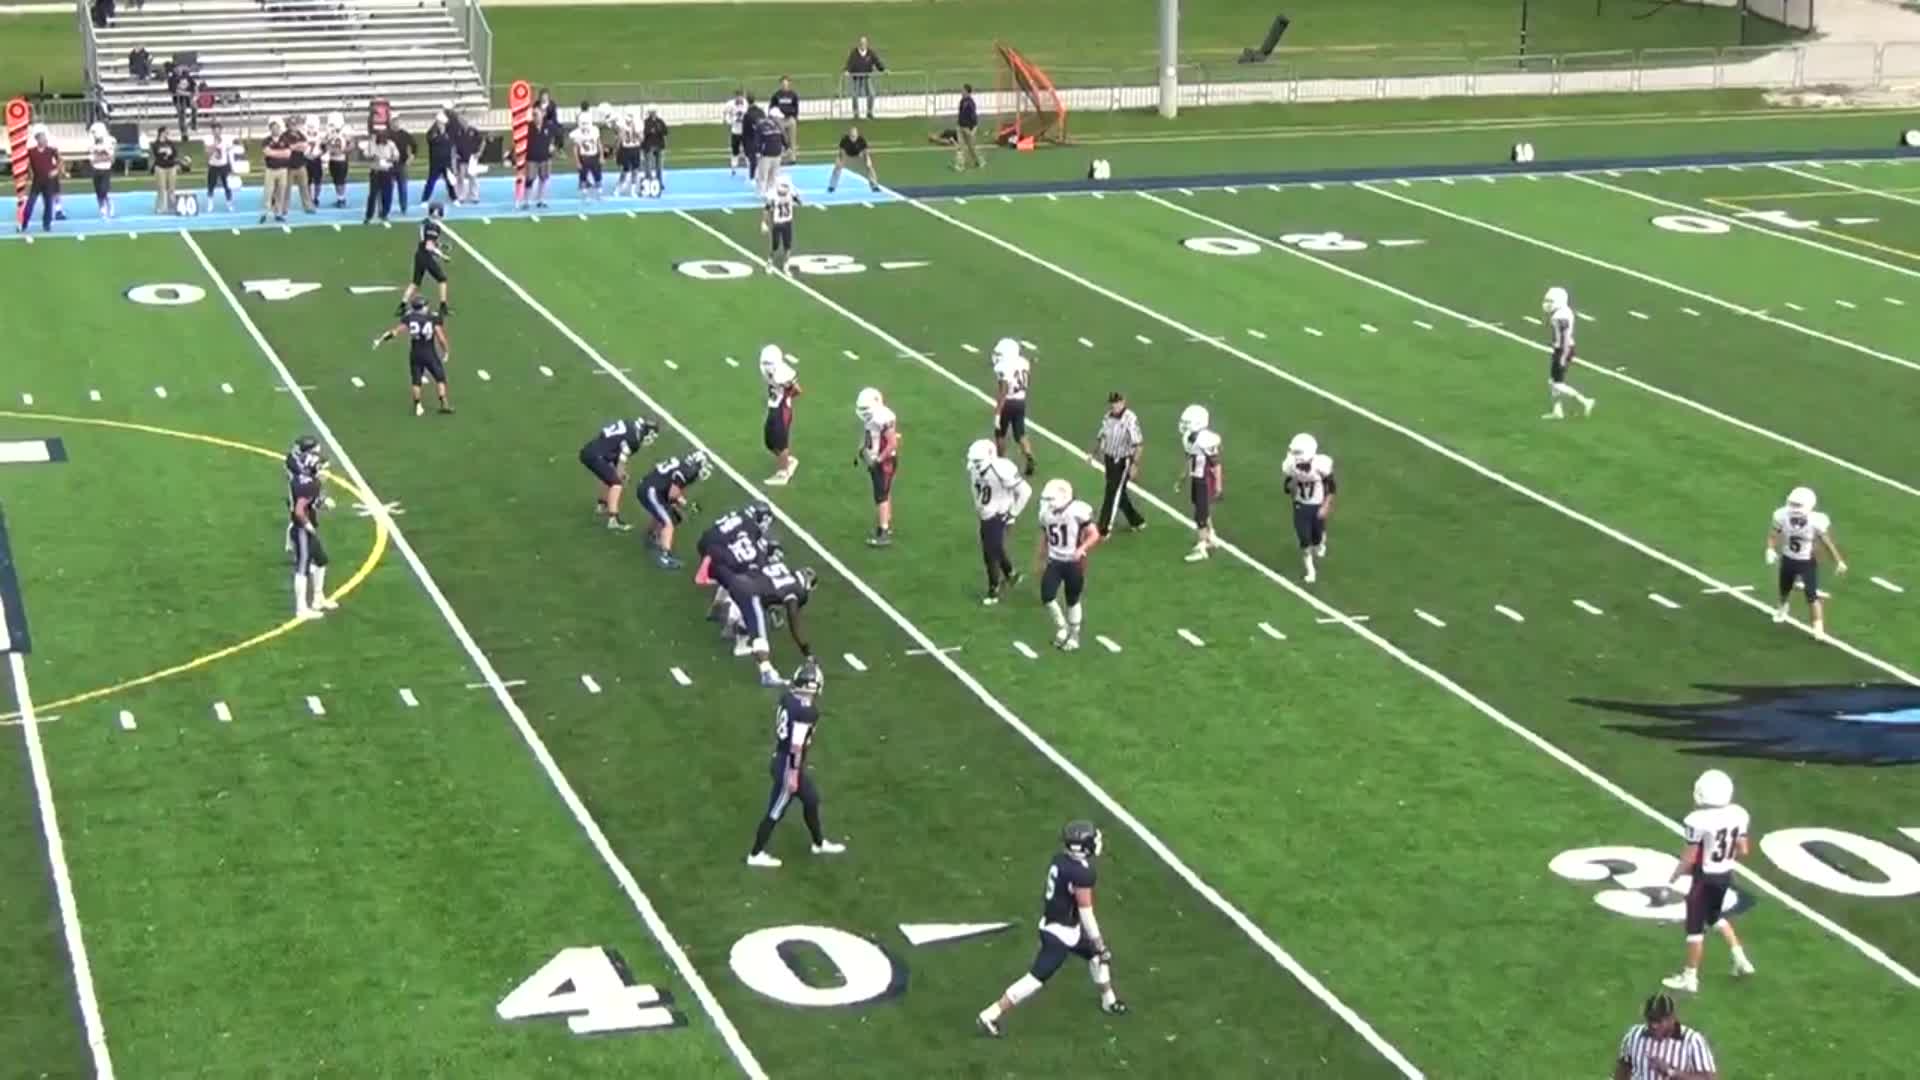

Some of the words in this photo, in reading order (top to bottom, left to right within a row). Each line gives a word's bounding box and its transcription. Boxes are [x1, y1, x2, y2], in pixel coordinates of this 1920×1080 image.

[176, 196, 197, 214] 40
[409, 321, 434, 341] 24
[1049, 523, 1068, 547] 51
[762, 563, 796, 590] 51
[1711, 826, 1739, 863] 31
